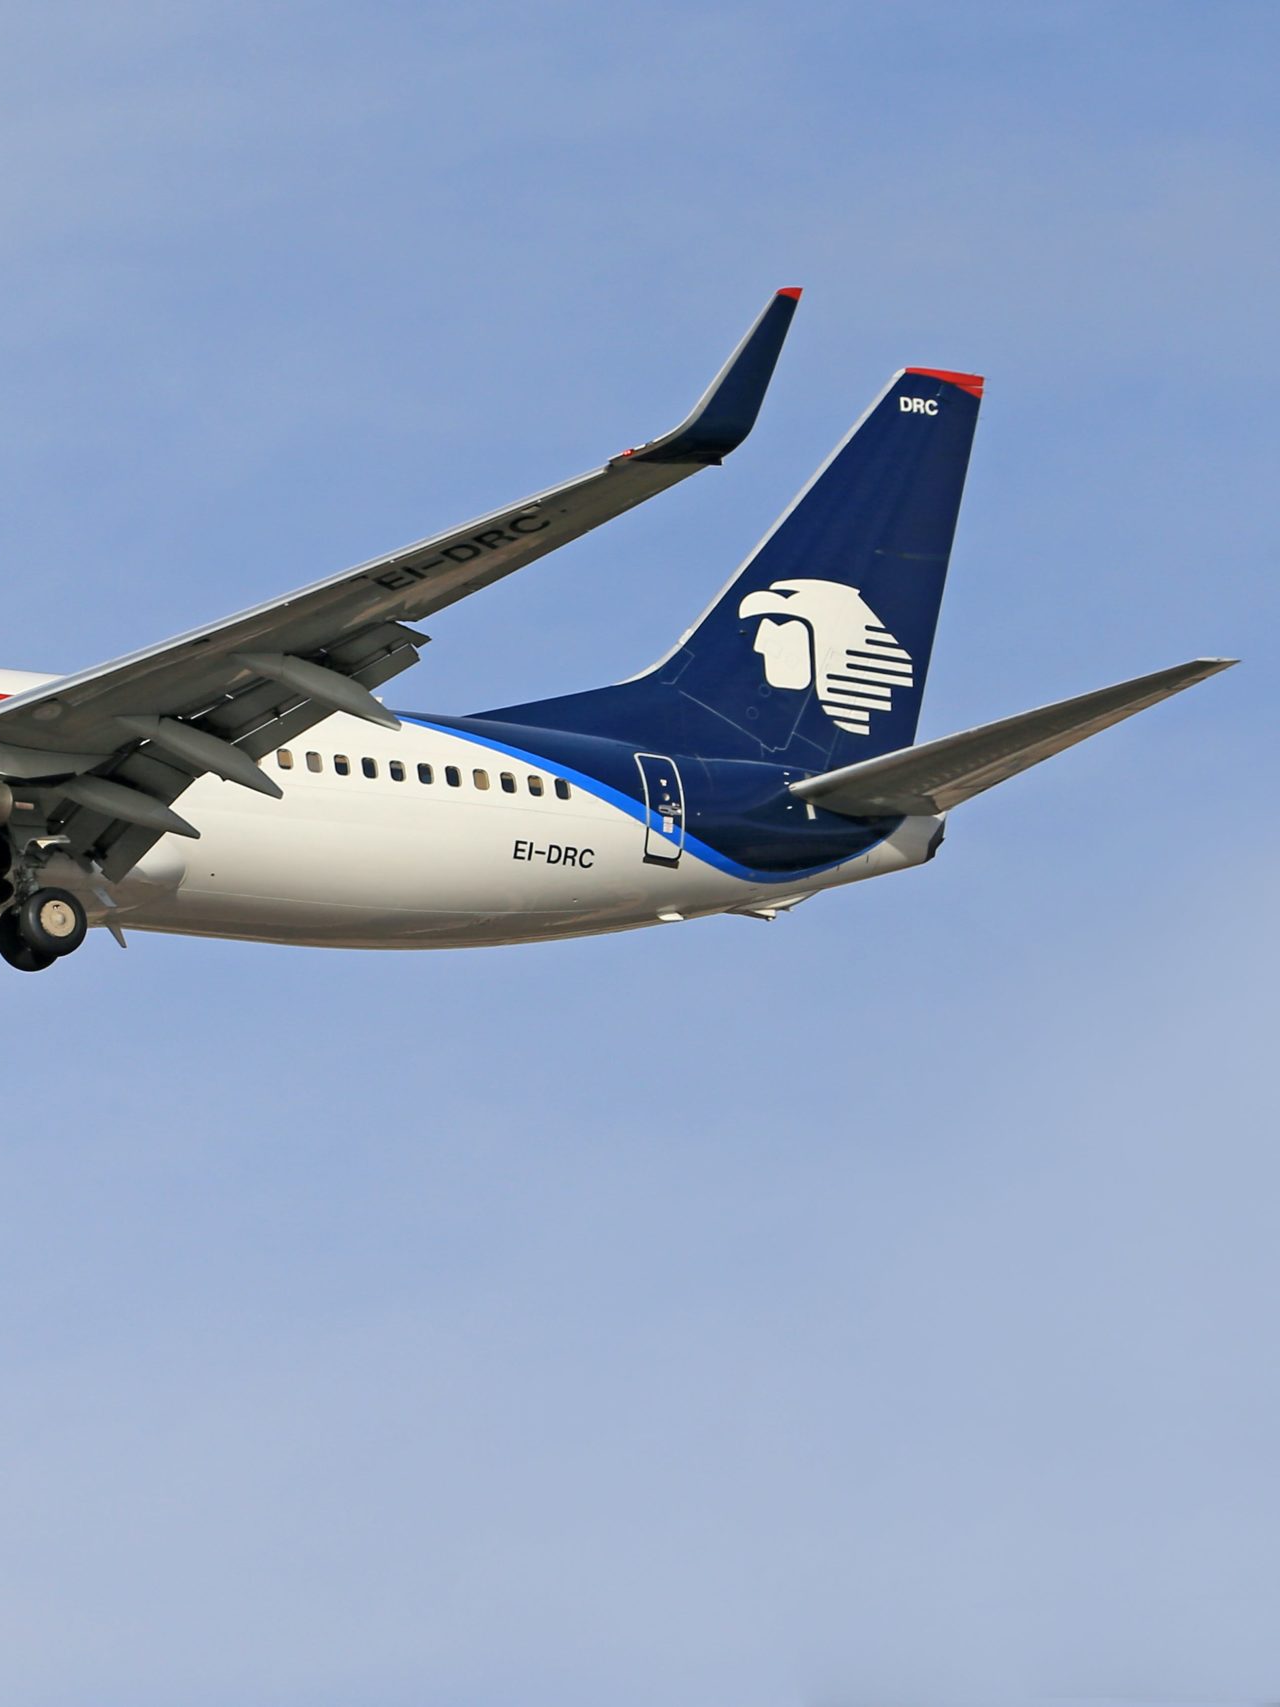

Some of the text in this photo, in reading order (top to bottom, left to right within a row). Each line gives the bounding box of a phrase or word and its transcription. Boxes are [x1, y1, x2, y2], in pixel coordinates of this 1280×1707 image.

[899, 396, 939, 416] DRC
[372, 514, 551, 591] EI-DRC
[513, 840, 595, 869] EI-DRC
